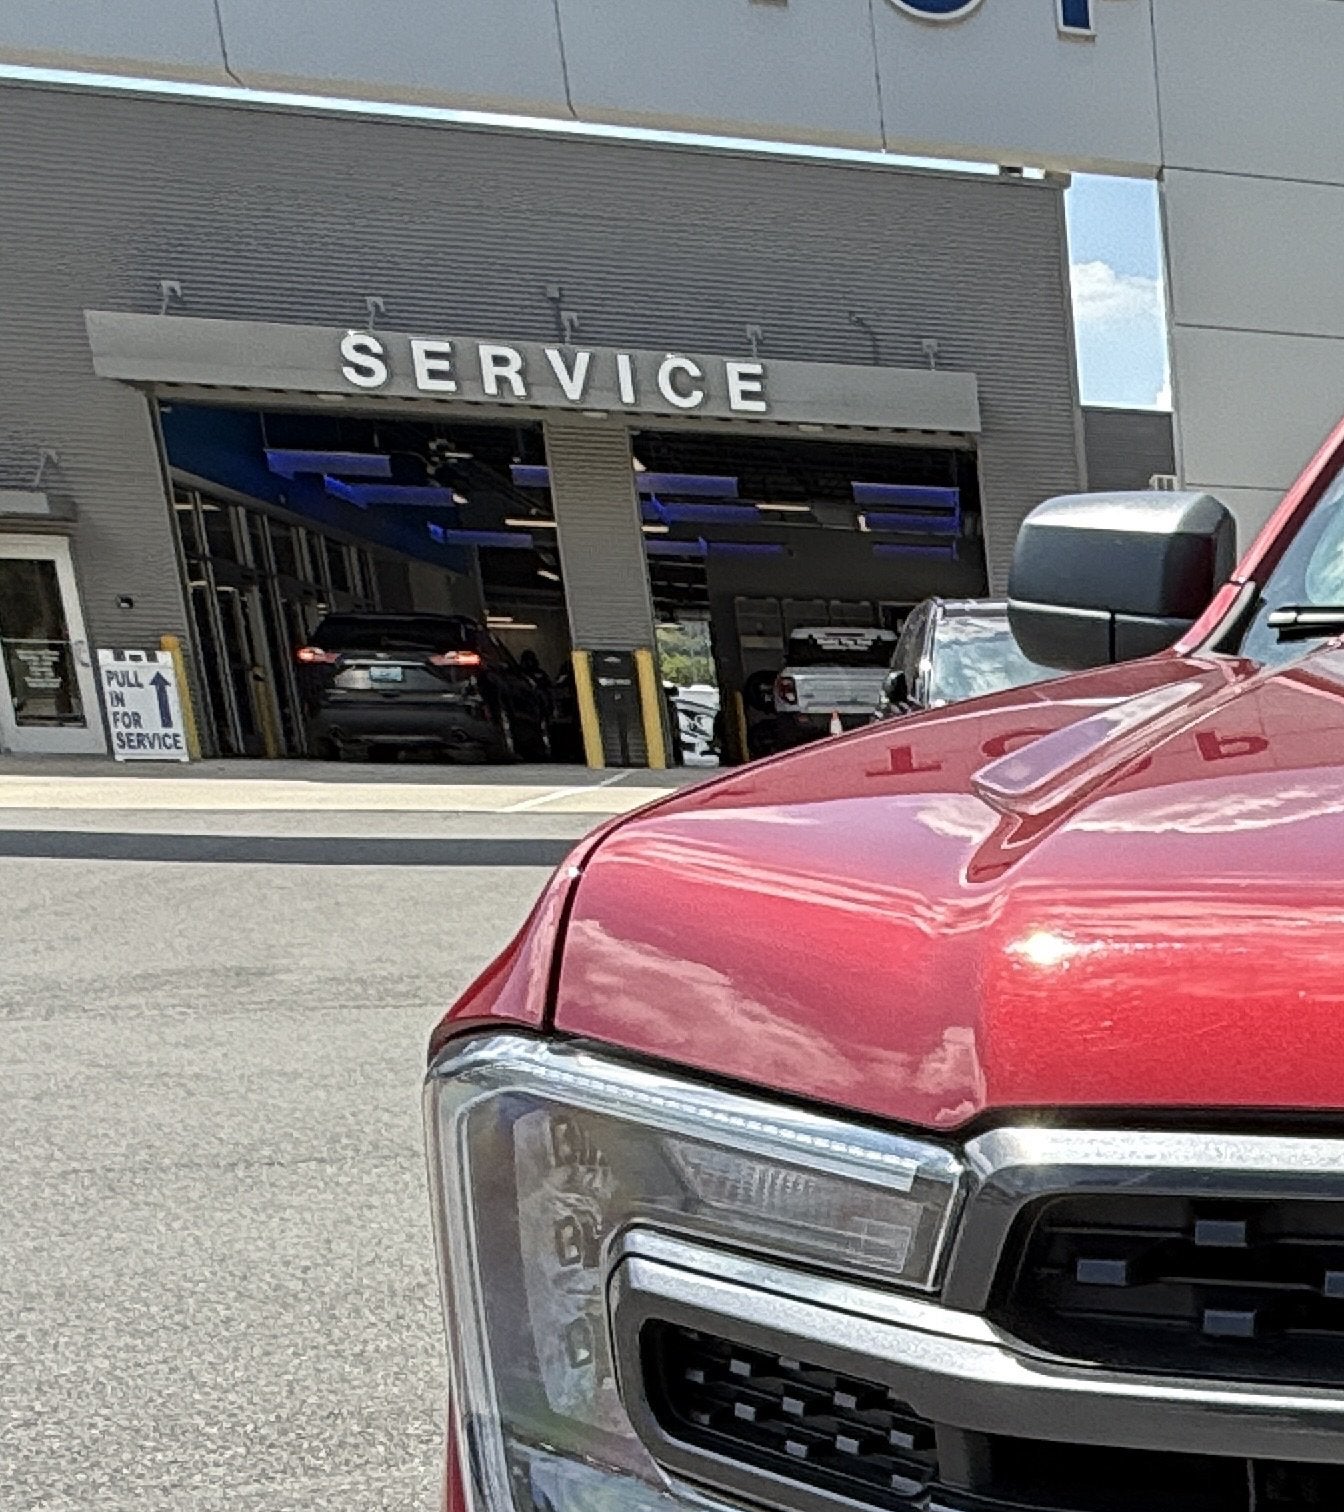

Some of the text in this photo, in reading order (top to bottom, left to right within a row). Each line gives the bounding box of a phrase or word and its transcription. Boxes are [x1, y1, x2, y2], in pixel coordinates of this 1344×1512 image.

[340, 332, 767, 412] SERVICE
[105, 670, 144, 689] PULL
[110, 691, 126, 708] IN
[113, 711, 143, 729] FOR
[116, 731, 183, 750] SERVICE
